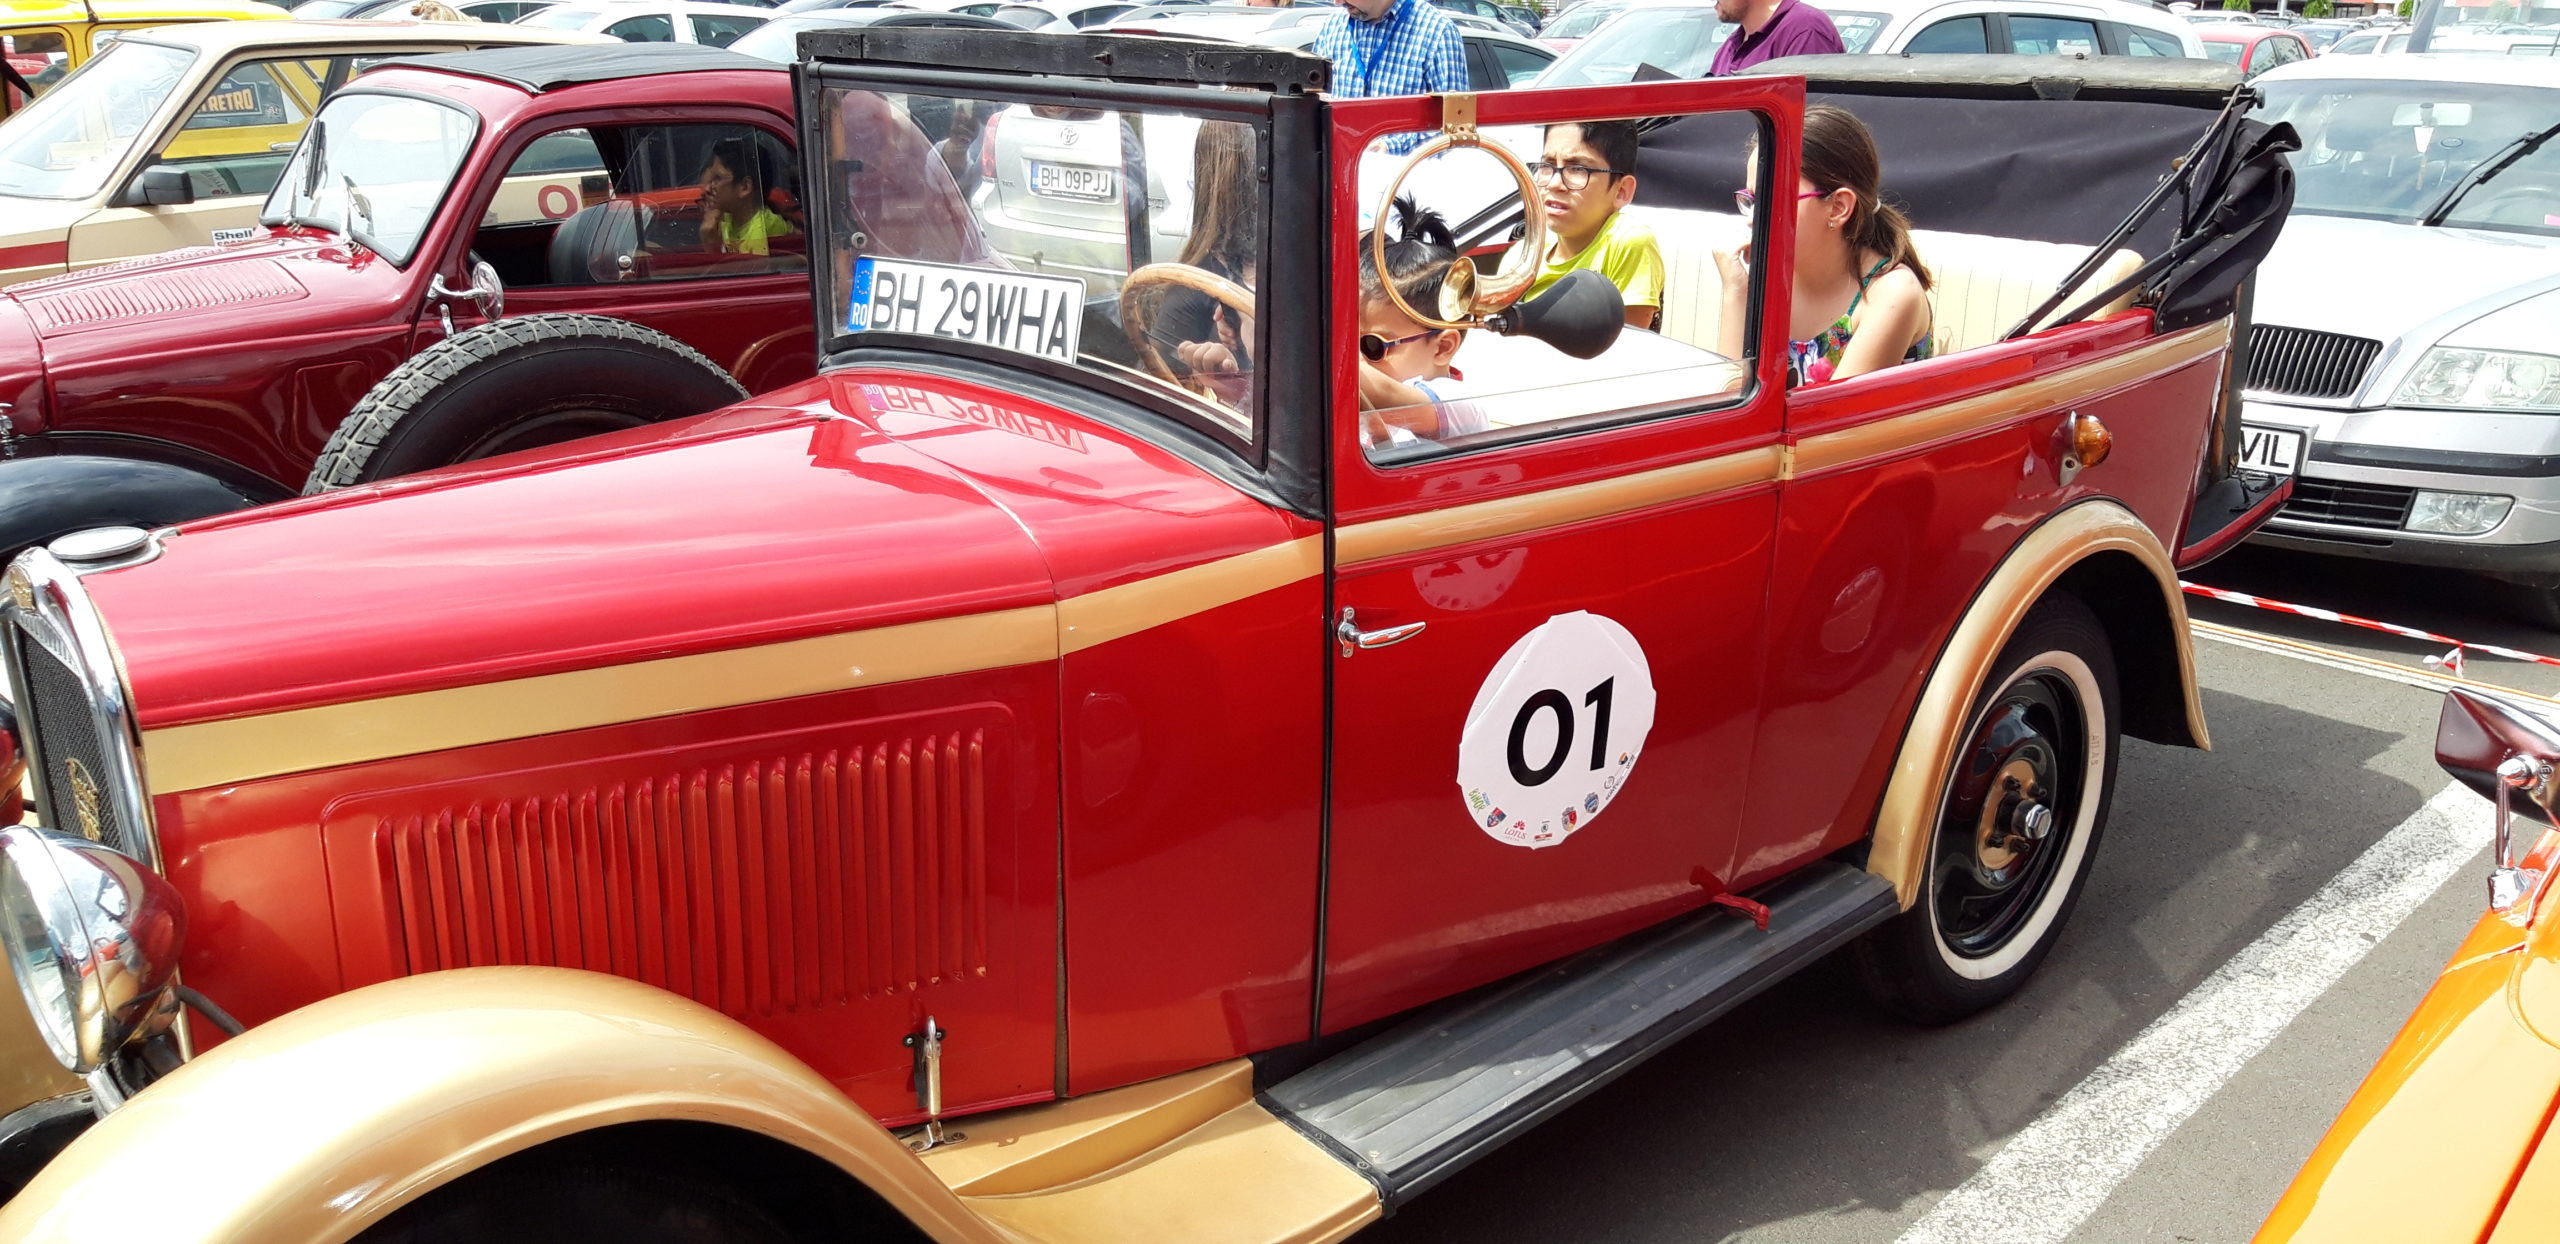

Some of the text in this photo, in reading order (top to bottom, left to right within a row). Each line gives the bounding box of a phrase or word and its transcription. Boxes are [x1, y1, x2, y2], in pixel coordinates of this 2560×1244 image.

[208, 88, 254, 111] RETRO
[1041, 167, 1109, 193] BH 09PJJ
[214, 230, 252, 240] Shell
[851, 302, 869, 326] RO
[871, 271, 1068, 358] BH 29WHA
[2240, 430, 2290, 469] VIL
[1507, 675, 1614, 787] 01
[1504, 828, 1527, 840] LOTUS
